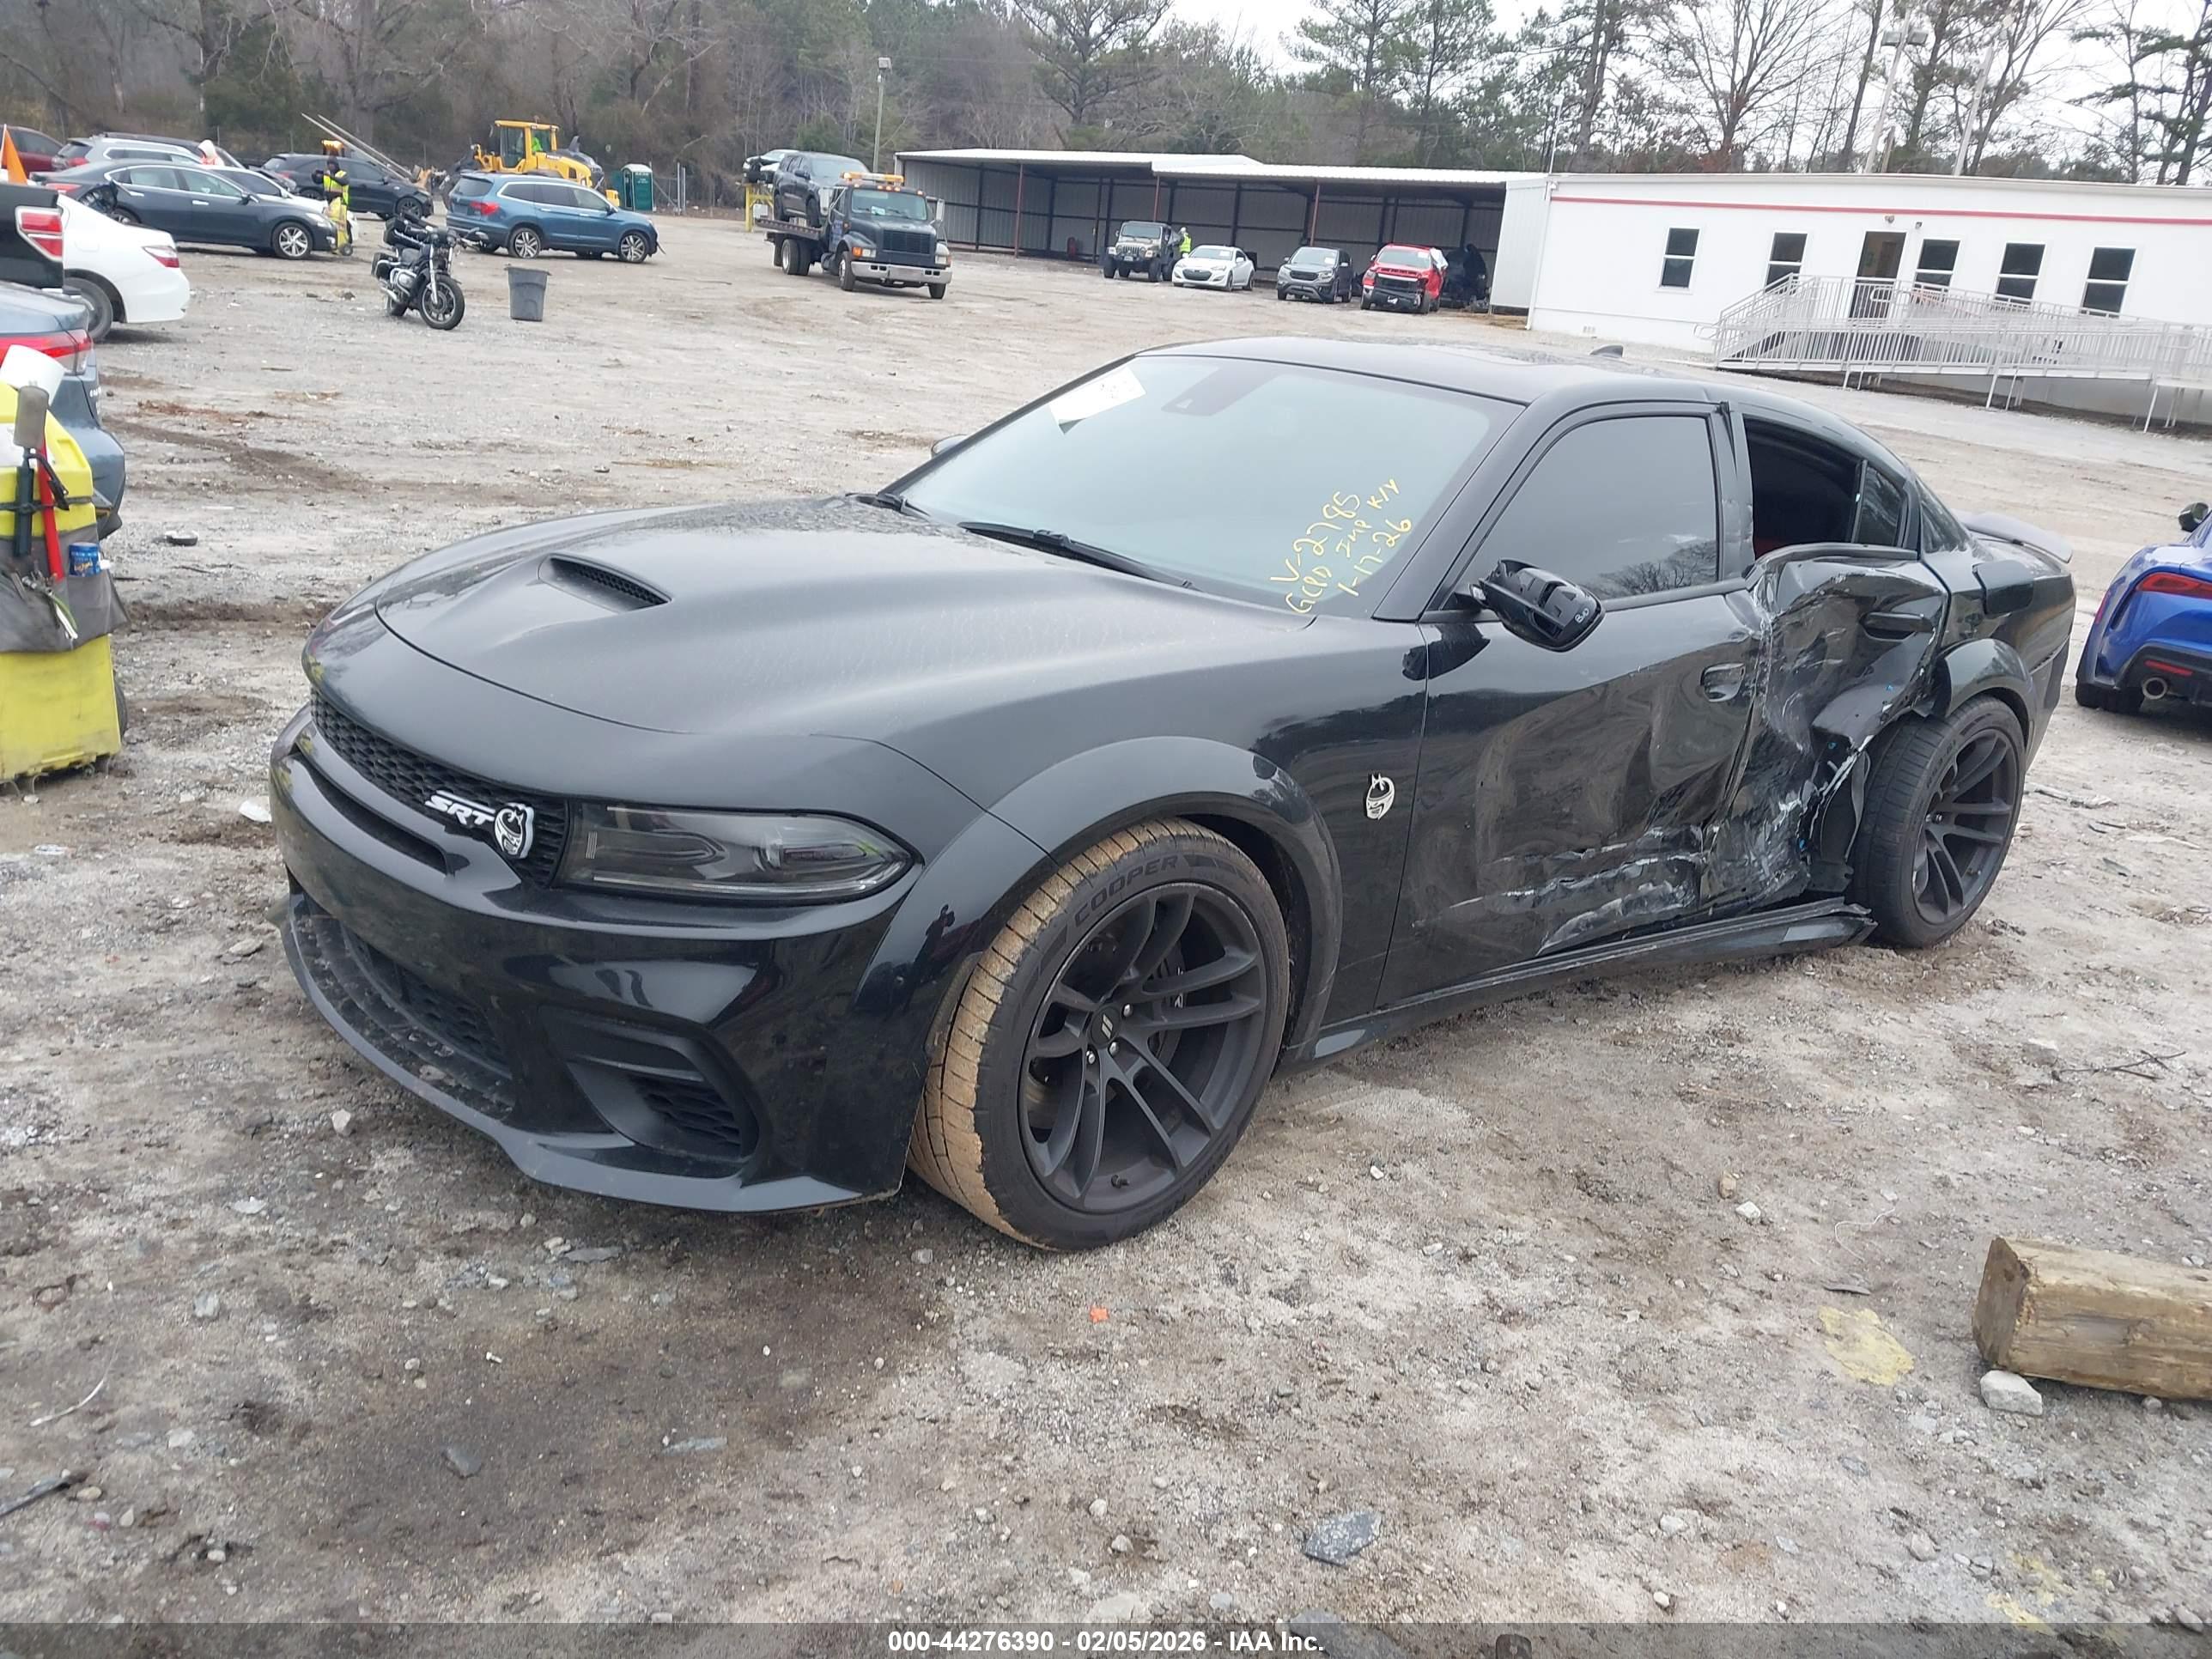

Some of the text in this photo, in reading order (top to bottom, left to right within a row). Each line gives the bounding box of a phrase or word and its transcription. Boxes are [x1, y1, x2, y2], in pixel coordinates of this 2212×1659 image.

[1270, 491, 1361, 582] V-2785
[1337, 519, 1412, 597] 1-17-26
[424, 794, 495, 825] SRT
[1074, 854, 1179, 927] COOPER
